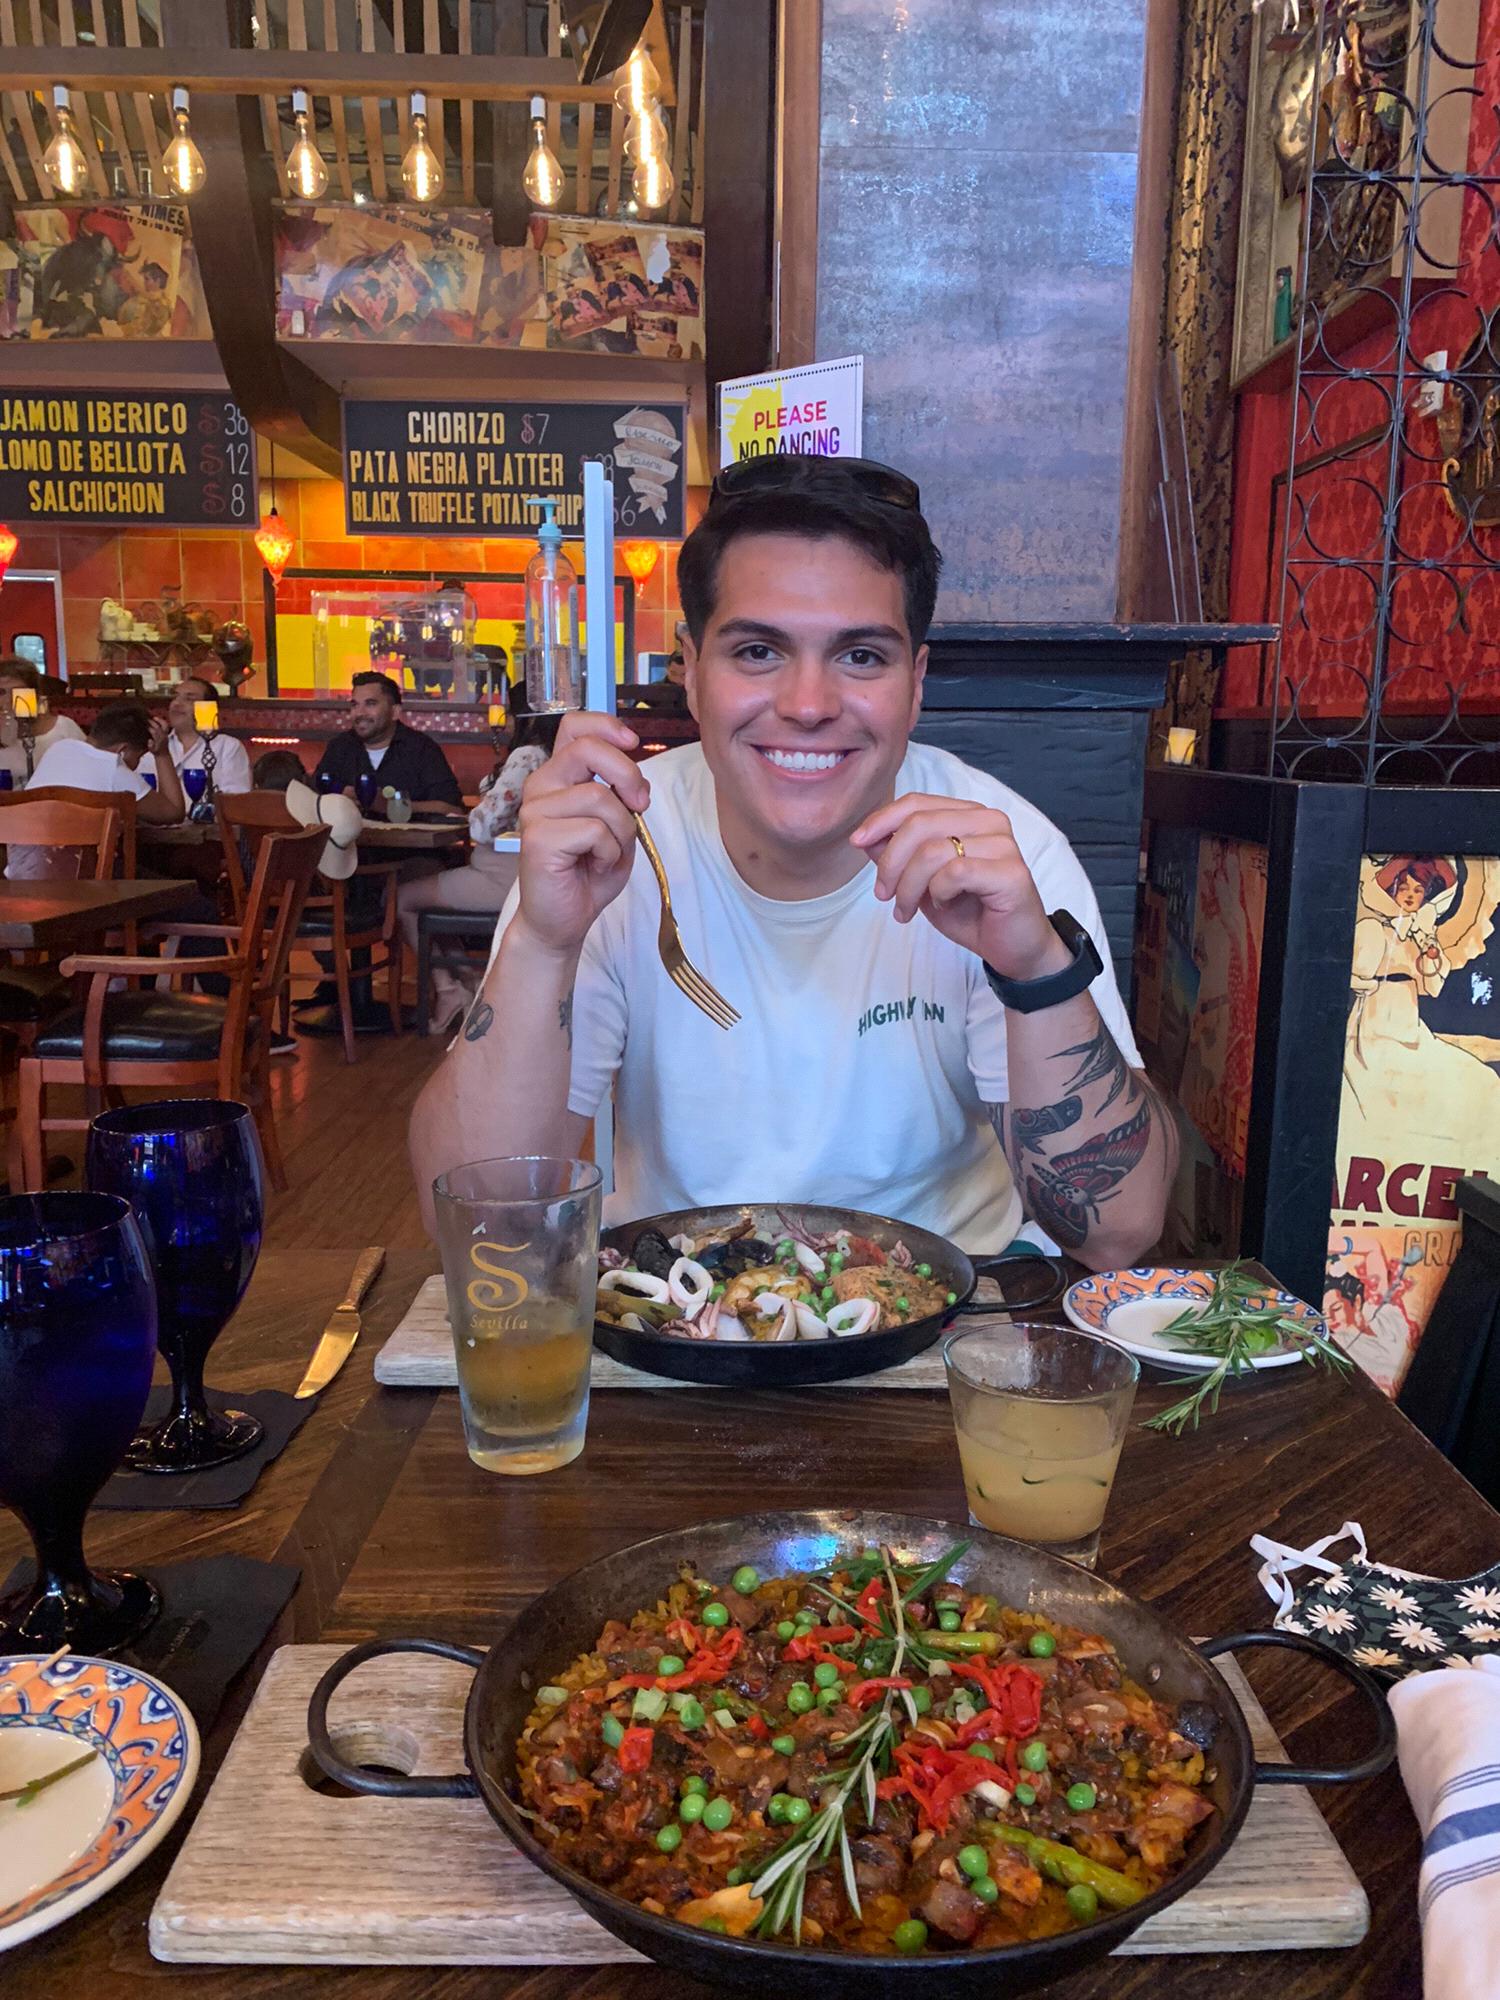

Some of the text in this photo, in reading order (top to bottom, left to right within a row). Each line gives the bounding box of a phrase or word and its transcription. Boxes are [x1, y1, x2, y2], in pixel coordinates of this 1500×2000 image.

[0, 399, 79, 432] JAMON
[87, 401, 188, 435] IBERICO
[408, 411, 550, 445] CHORIZO $7
[754, 400, 827, 432] PLEASE
[0, 438, 53, 472] LOMO
[58, 439, 84, 473] DE
[90, 440, 187, 475] BELLOTA
[739, 426, 840, 461] NO DANCING
[350, 450, 399, 484] PATA
[407, 451, 469, 486] NEGRA
[477, 452, 564, 487] PLATTER
[28, 480, 165, 515] SALCHICHON
[352, 491, 400, 523] BLACK
[408, 492, 475, 524] TRUFFLE
[482, 493, 540, 525] POTATO
[546, 494, 584, 526] HIP
[1331, 1156, 1488, 1221] RCE
[470, 1313, 528, 1330] Sevilla
